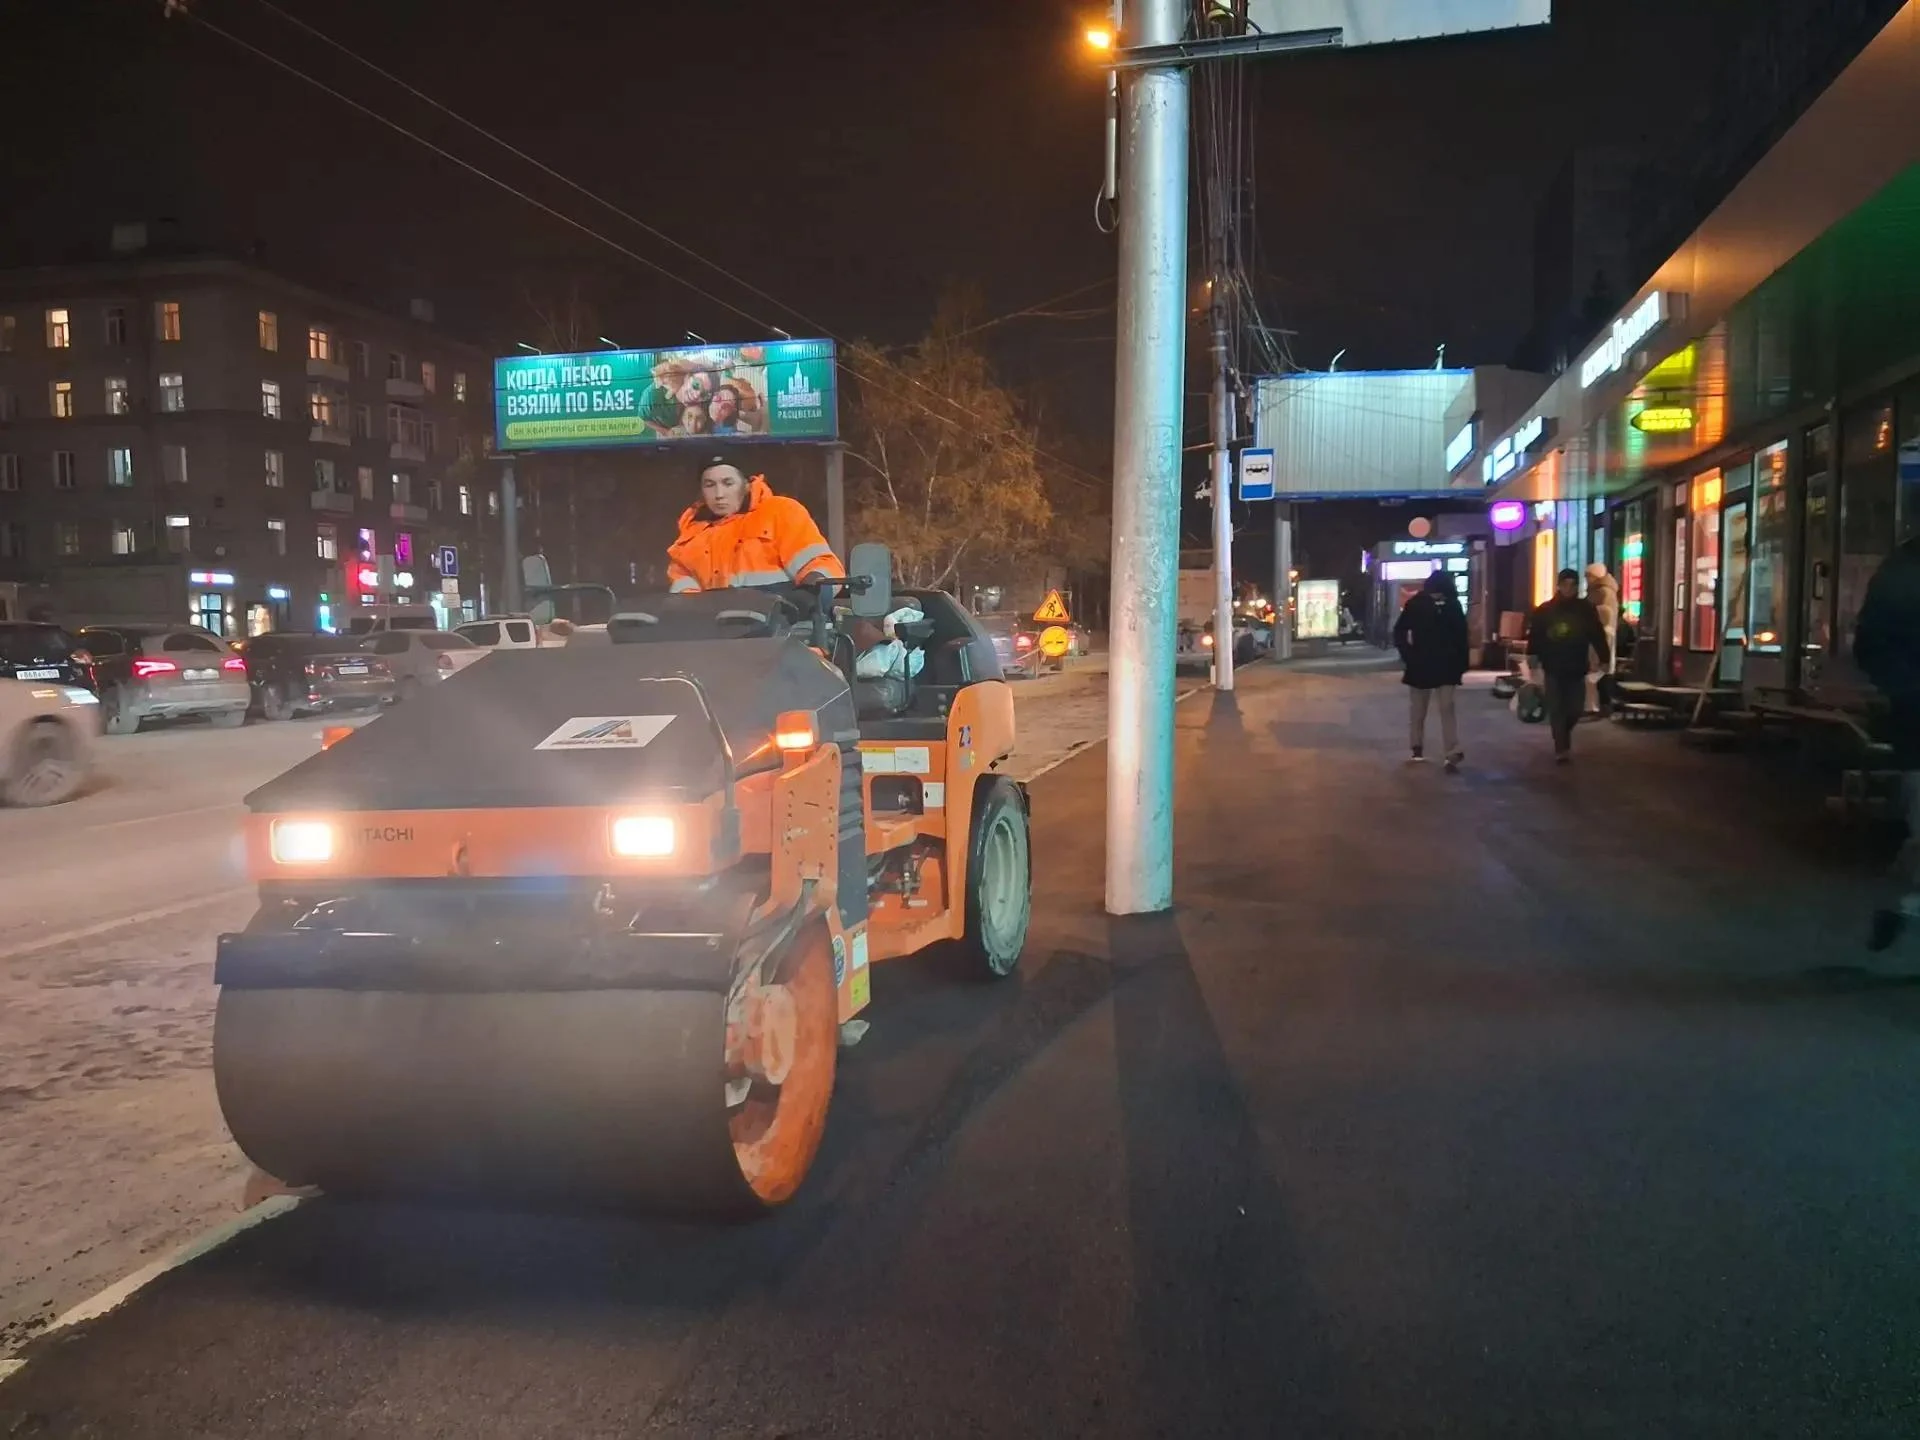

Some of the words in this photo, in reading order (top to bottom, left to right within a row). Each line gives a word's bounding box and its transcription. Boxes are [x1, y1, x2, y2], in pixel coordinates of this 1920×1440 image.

[506, 367, 558, 392] КОГДА
[561, 364, 612, 388] ЛЕГКО
[507, 393, 561, 416] ВЗЯЛИ
[565, 391, 588, 413] ПО
[593, 389, 635, 412] БАЗЕ
[444, 551, 455, 573] P
[358, 827, 414, 842] TACHI
